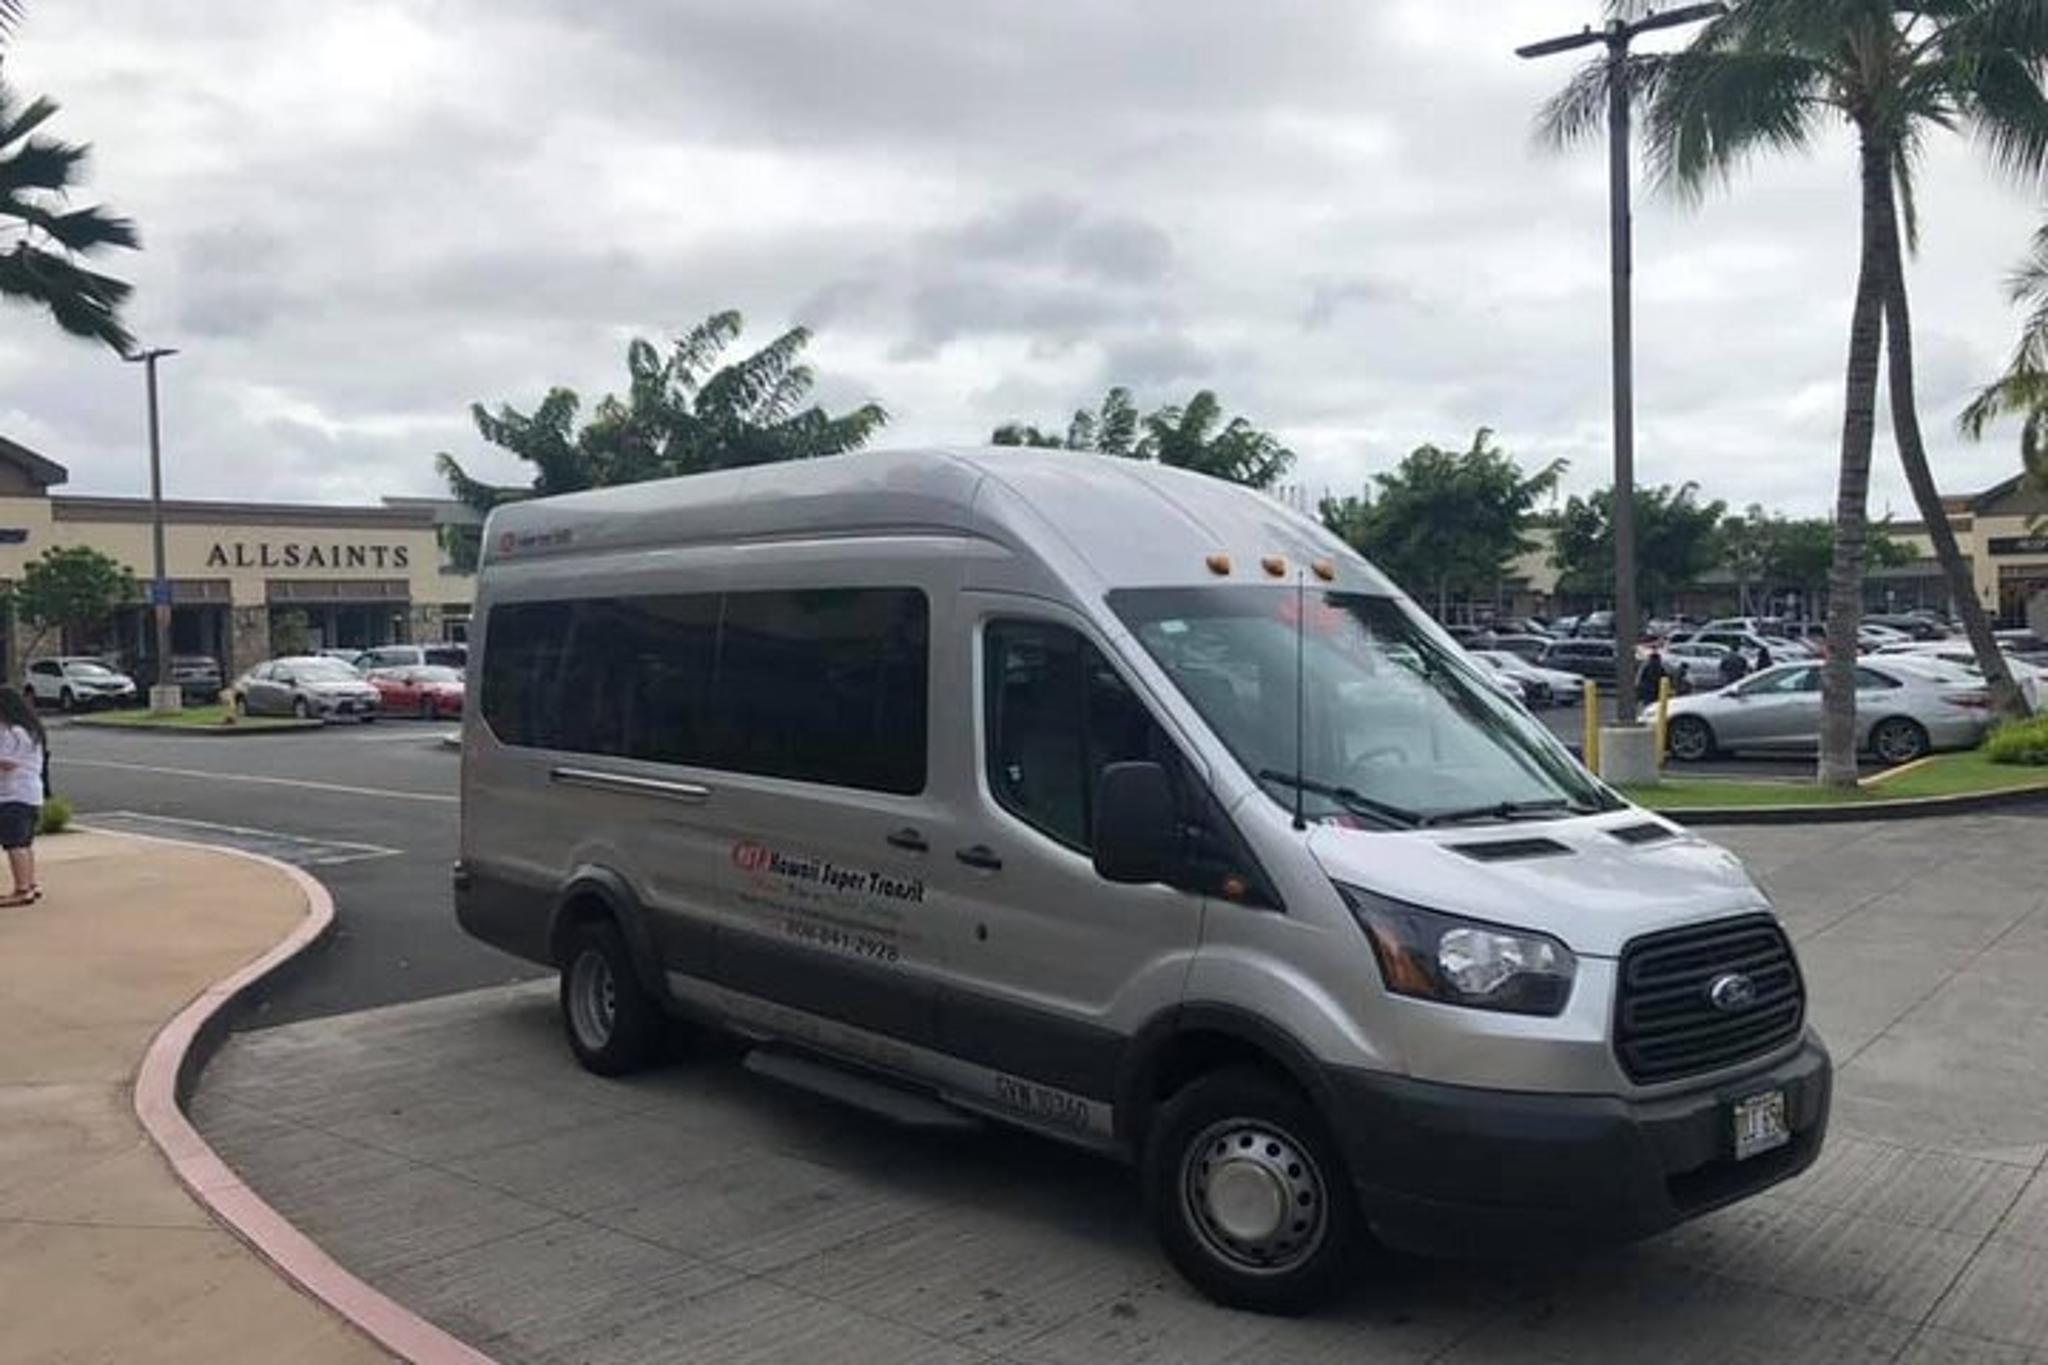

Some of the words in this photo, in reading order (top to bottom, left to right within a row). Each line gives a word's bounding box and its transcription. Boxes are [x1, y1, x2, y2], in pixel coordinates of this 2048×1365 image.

[206, 542, 409, 568] ALLSAINTS
[821, 863, 866, 891] Super
[869, 871, 925, 902] Transit
